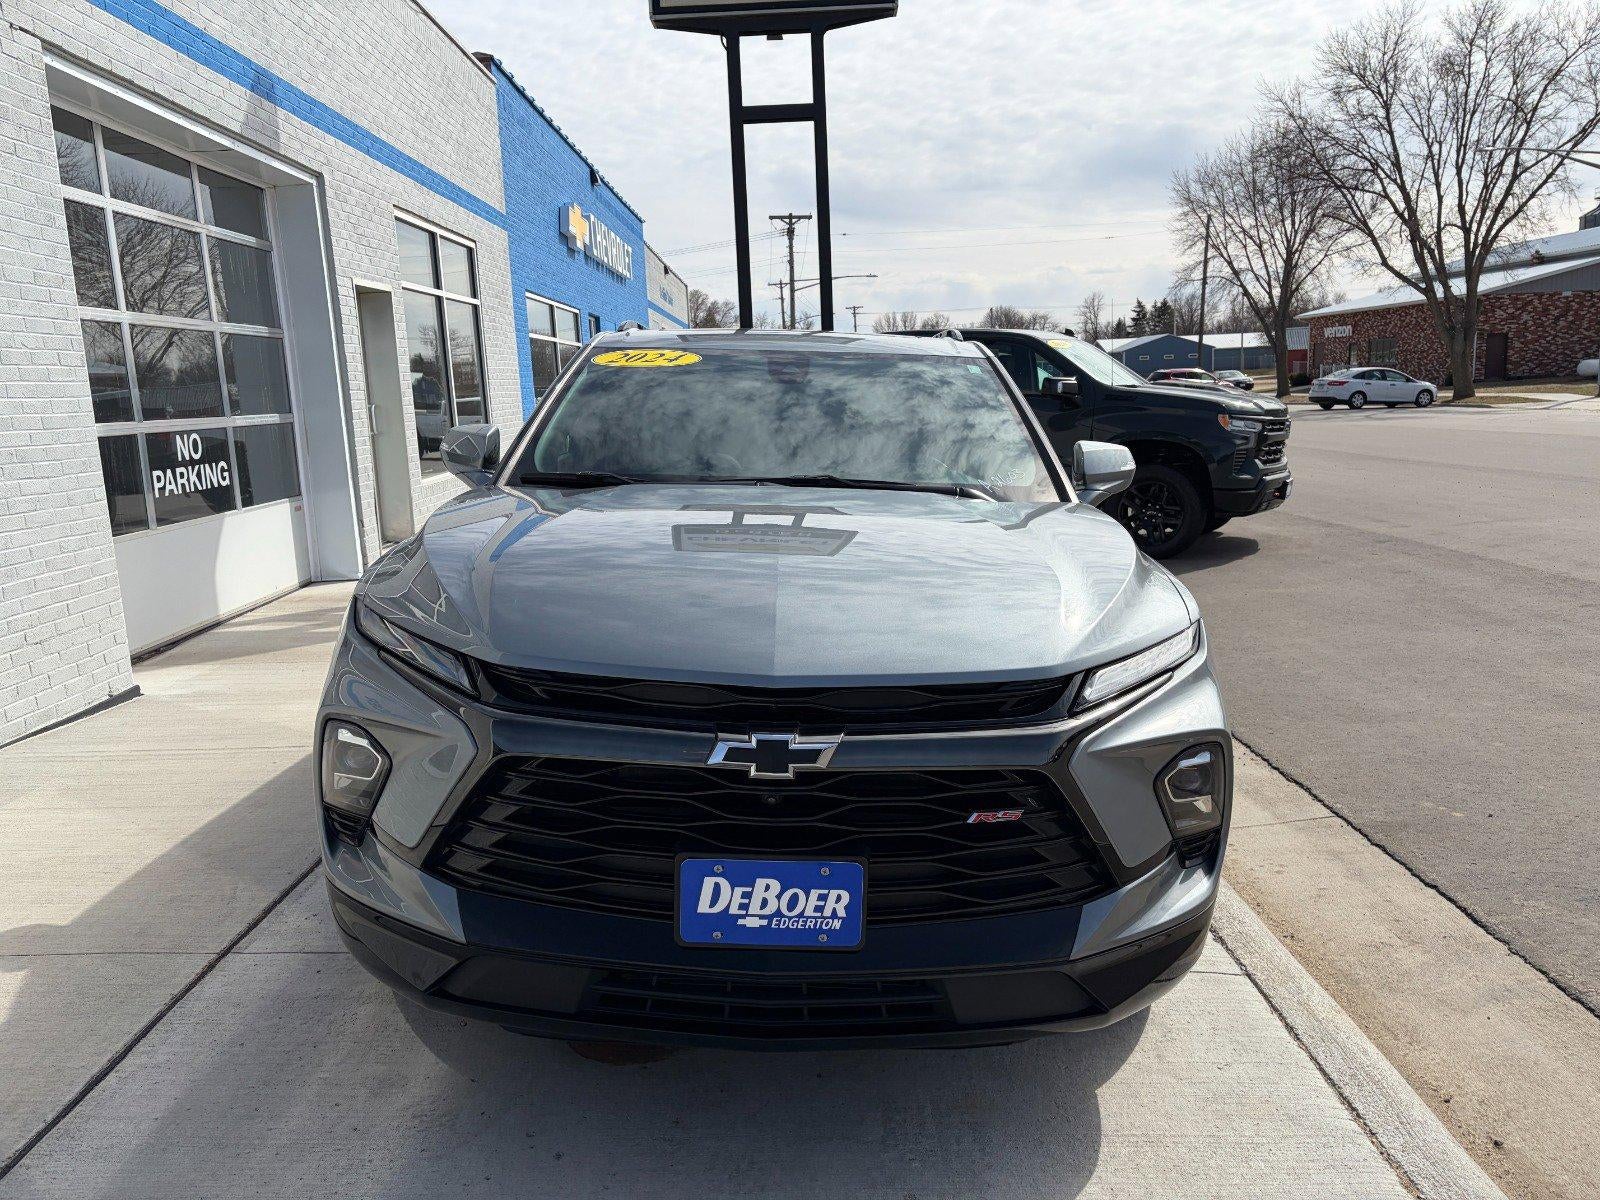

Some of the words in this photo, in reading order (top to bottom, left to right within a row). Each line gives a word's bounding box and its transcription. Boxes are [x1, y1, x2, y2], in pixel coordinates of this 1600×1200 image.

[589, 212, 632, 280] CHEVROLET
[1324, 324, 1352, 338] verizon
[605, 352, 688, 363] 2024
[176, 433, 202, 462] NO
[152, 461, 230, 498] PARKING
[966, 809, 1024, 823] RS
[771, 917, 843, 930] EDGERTON
